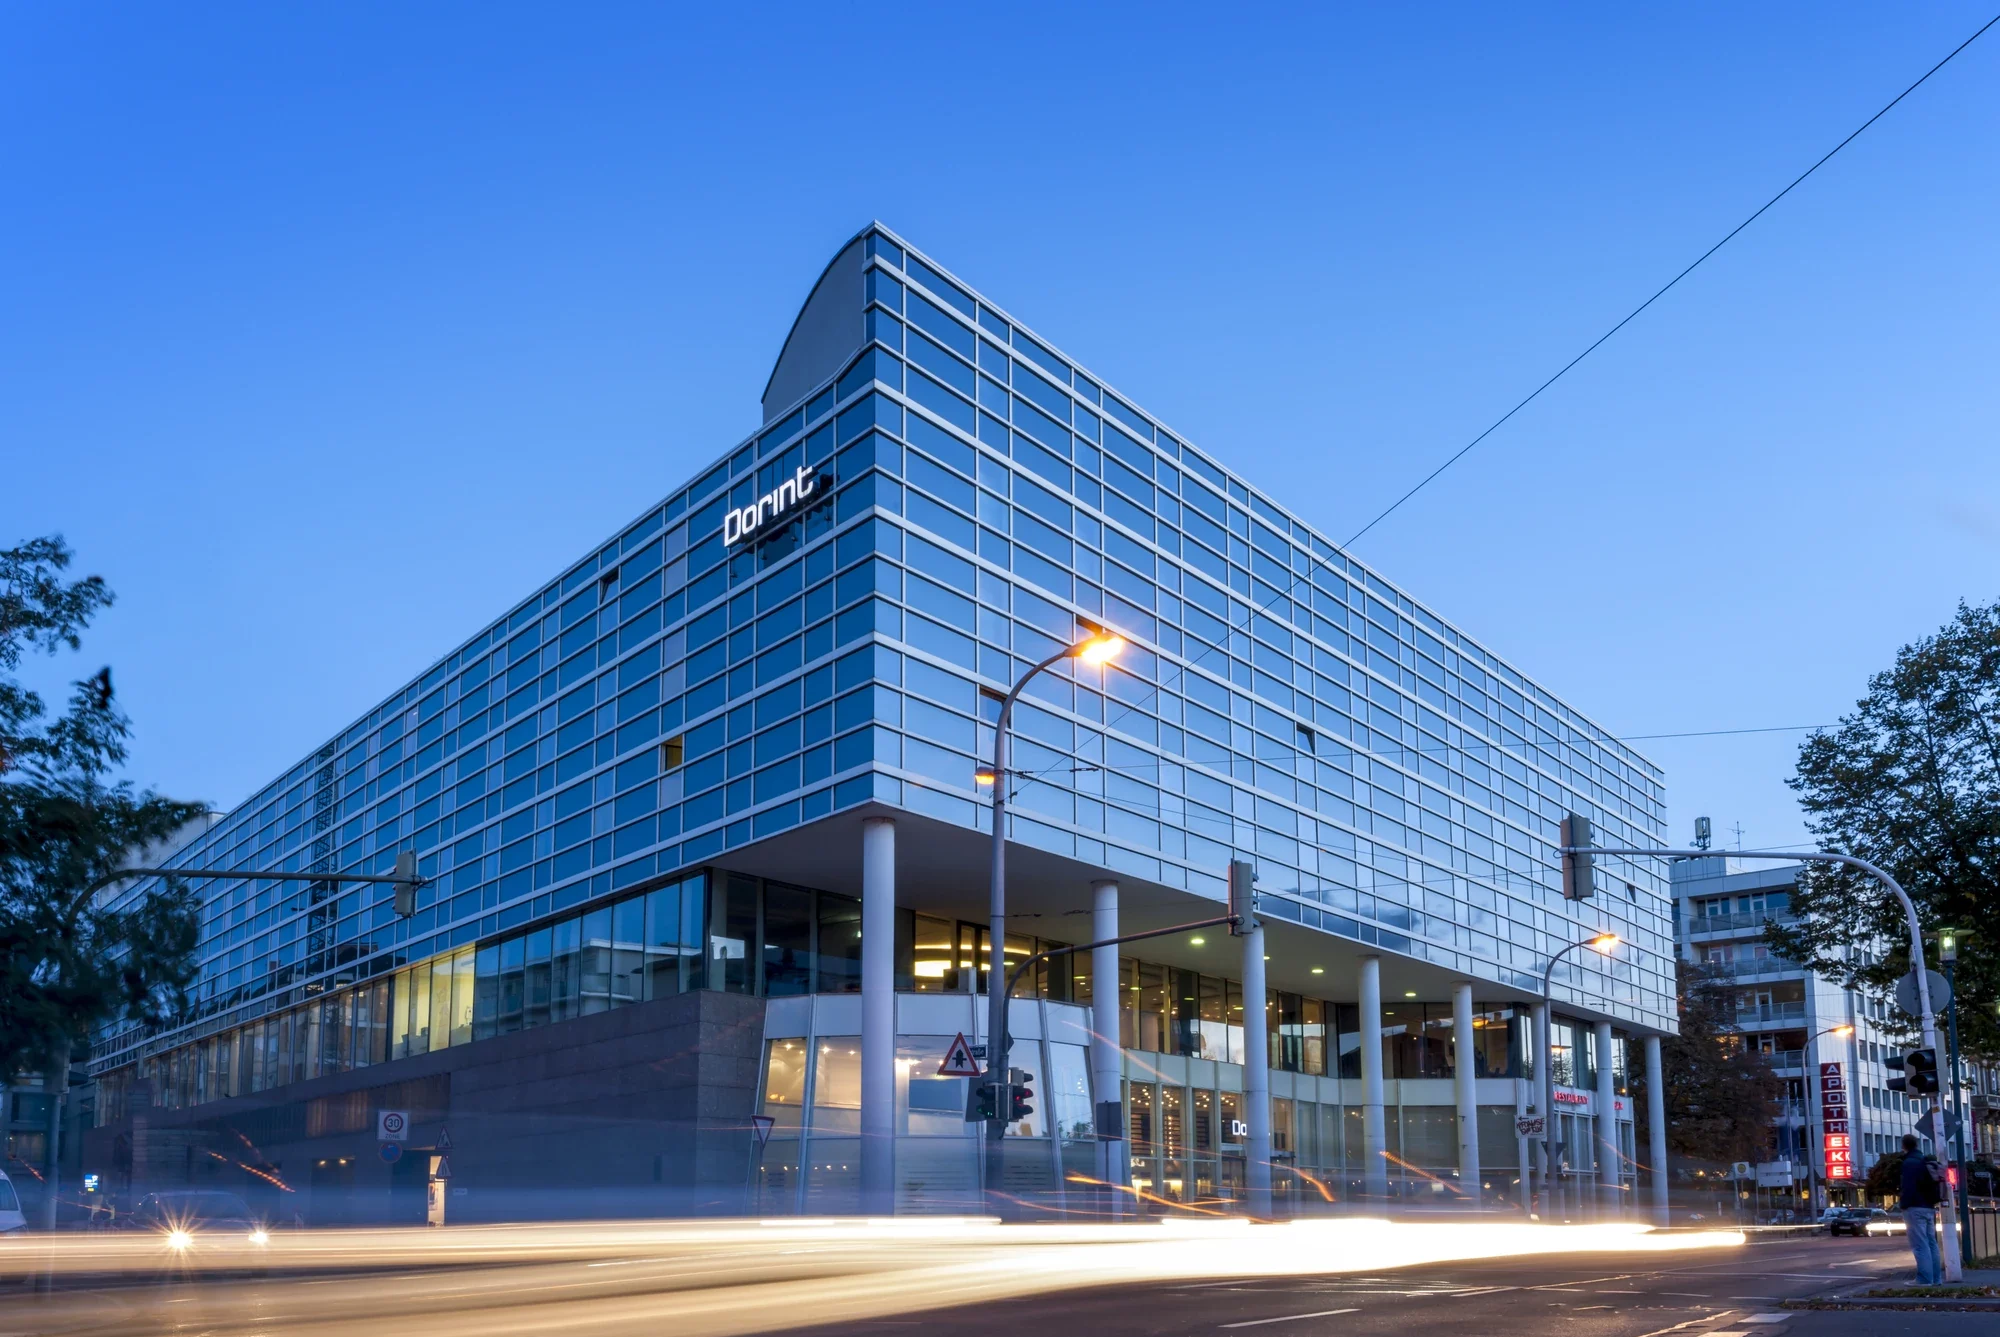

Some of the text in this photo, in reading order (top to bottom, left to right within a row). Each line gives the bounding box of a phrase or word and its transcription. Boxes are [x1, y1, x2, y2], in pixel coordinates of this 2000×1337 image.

[724, 465, 814, 548] Dorint
[387, 1118, 400, 1128] 30
[1826, 1064, 1845, 1176] APOTHEKE
